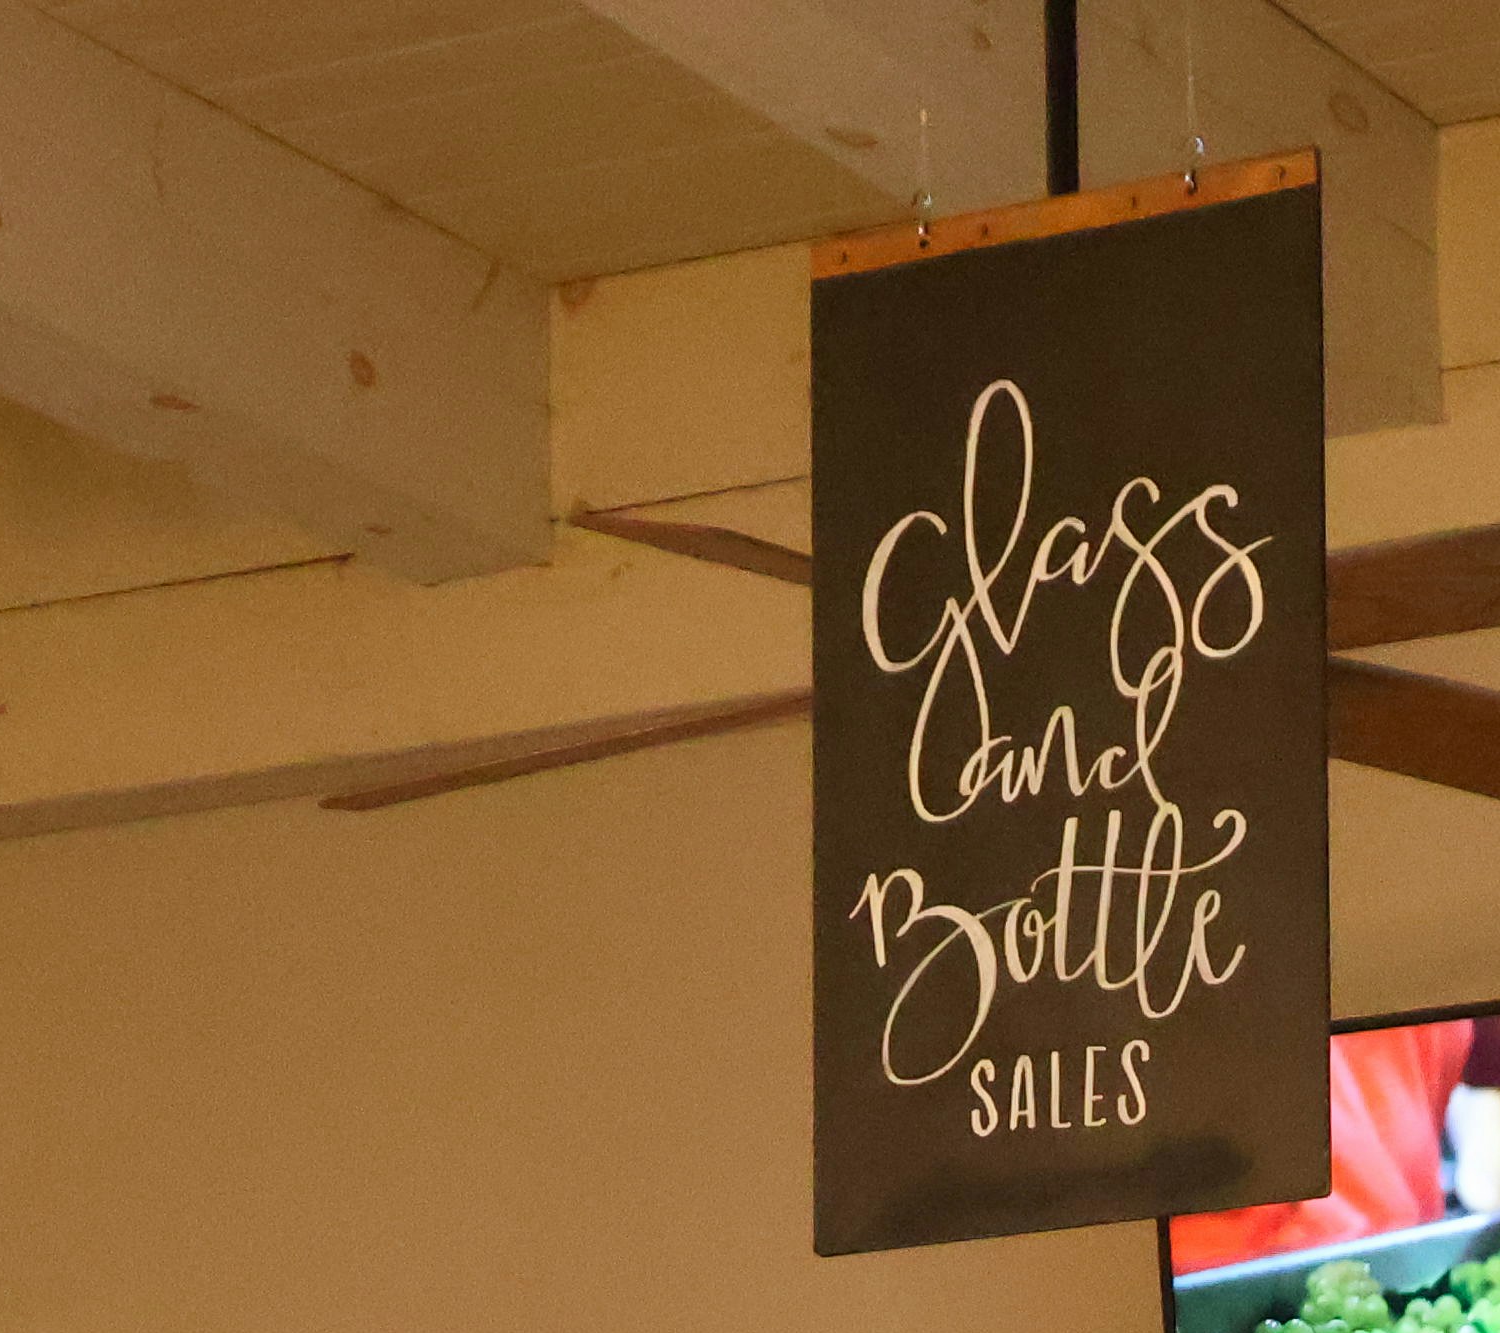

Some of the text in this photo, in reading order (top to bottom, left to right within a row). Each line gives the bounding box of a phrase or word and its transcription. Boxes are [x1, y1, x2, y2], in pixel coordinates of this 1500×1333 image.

[862, 378, 1274, 823] Glass
[958, 645, 1184, 808] and
[846, 802, 1248, 1086] Bottle
[969, 1038, 1152, 1139] SALES
